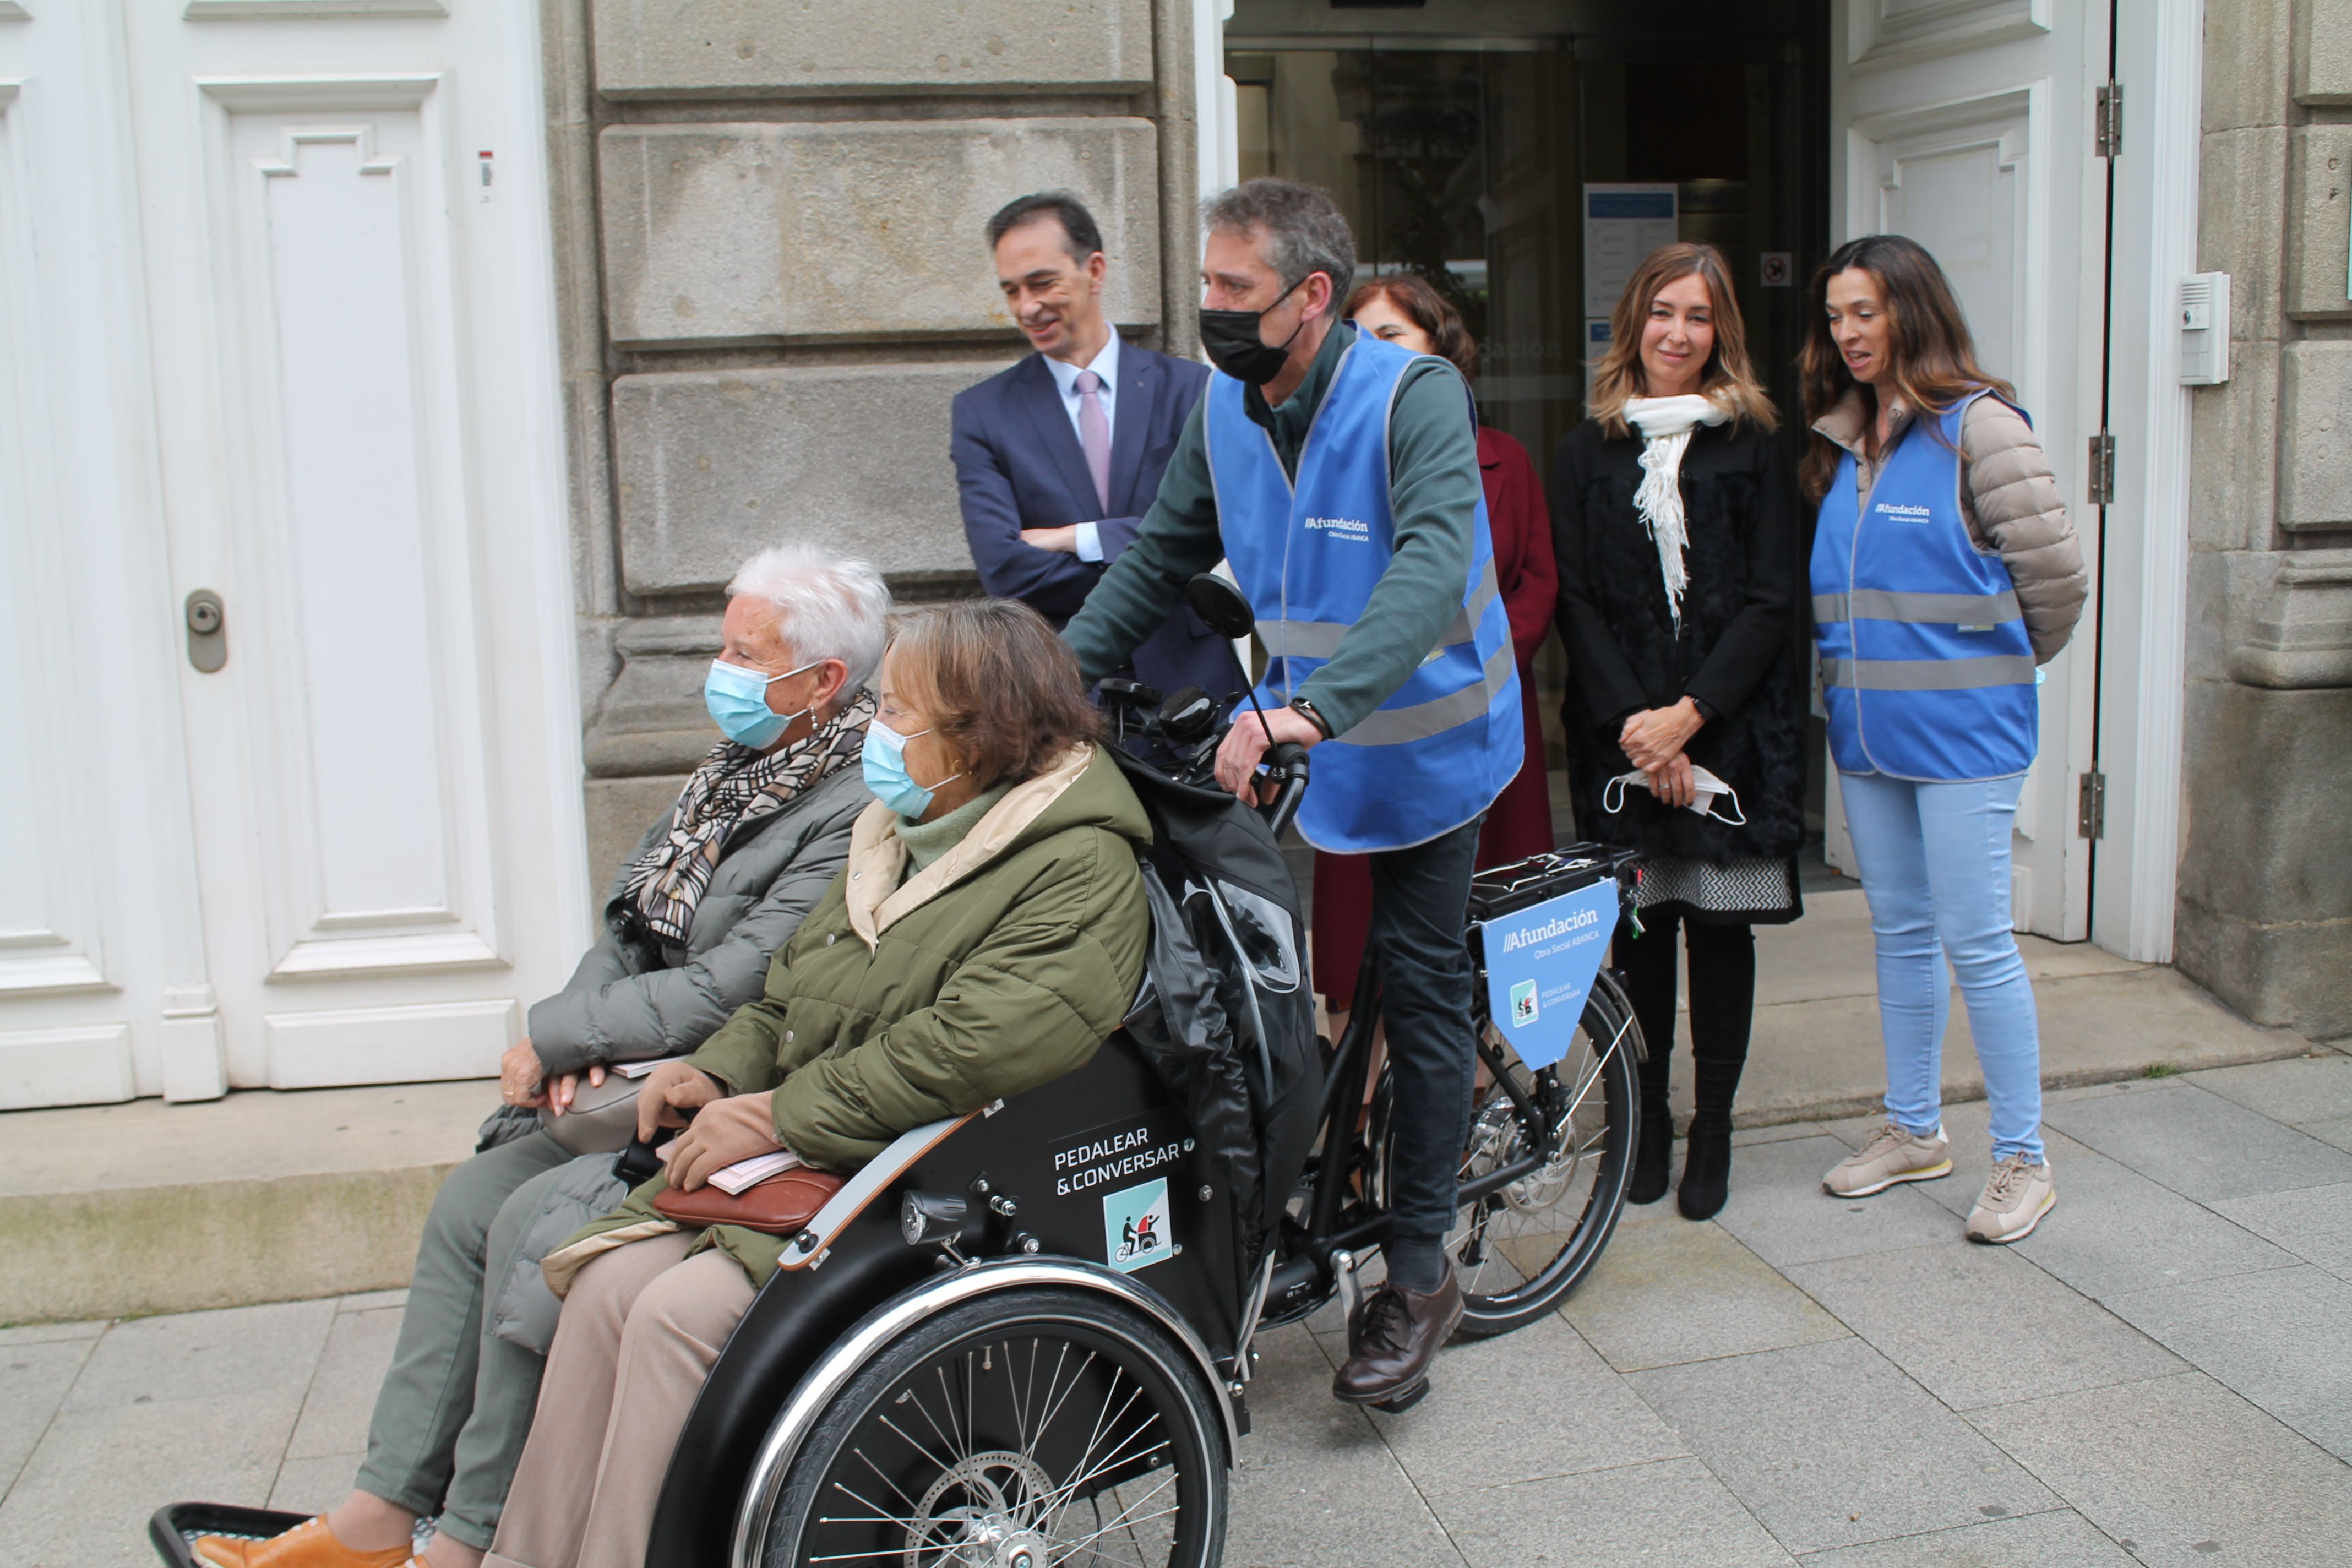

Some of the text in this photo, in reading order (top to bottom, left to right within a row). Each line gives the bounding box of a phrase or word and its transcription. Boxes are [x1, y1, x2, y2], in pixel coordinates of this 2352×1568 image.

[1534, 930, 1600, 959] Obra Social ABANCA
[1542, 983, 1571, 998] PEDALEAR
[1055, 1128, 1148, 1171] PEDALEAR
